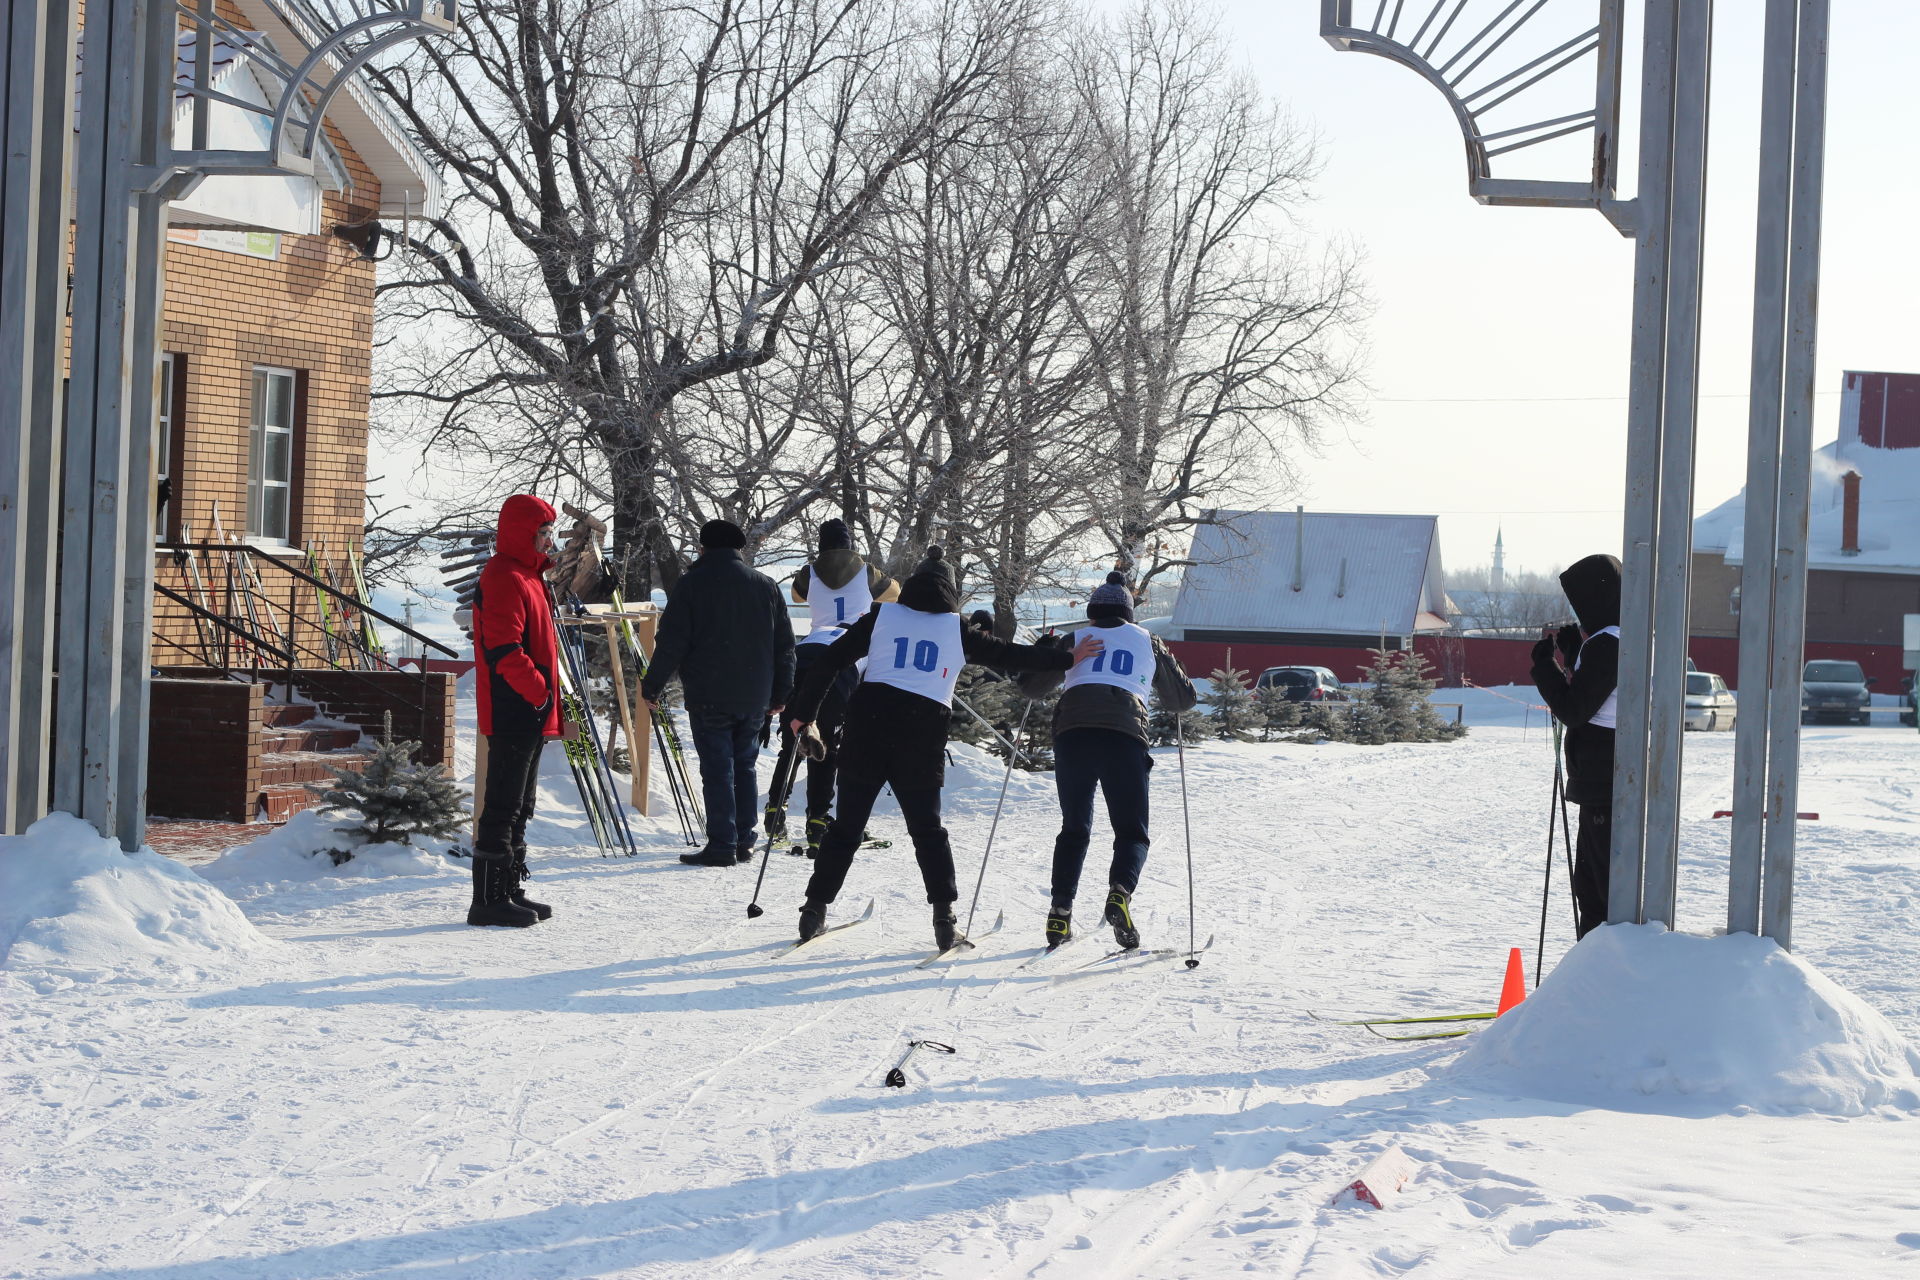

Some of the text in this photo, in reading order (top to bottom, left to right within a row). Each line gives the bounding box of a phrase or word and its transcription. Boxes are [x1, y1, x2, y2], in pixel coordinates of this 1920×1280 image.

[833, 596, 845, 621] 1
[893, 636, 939, 672] 10
[942, 667, 948, 679] 1
